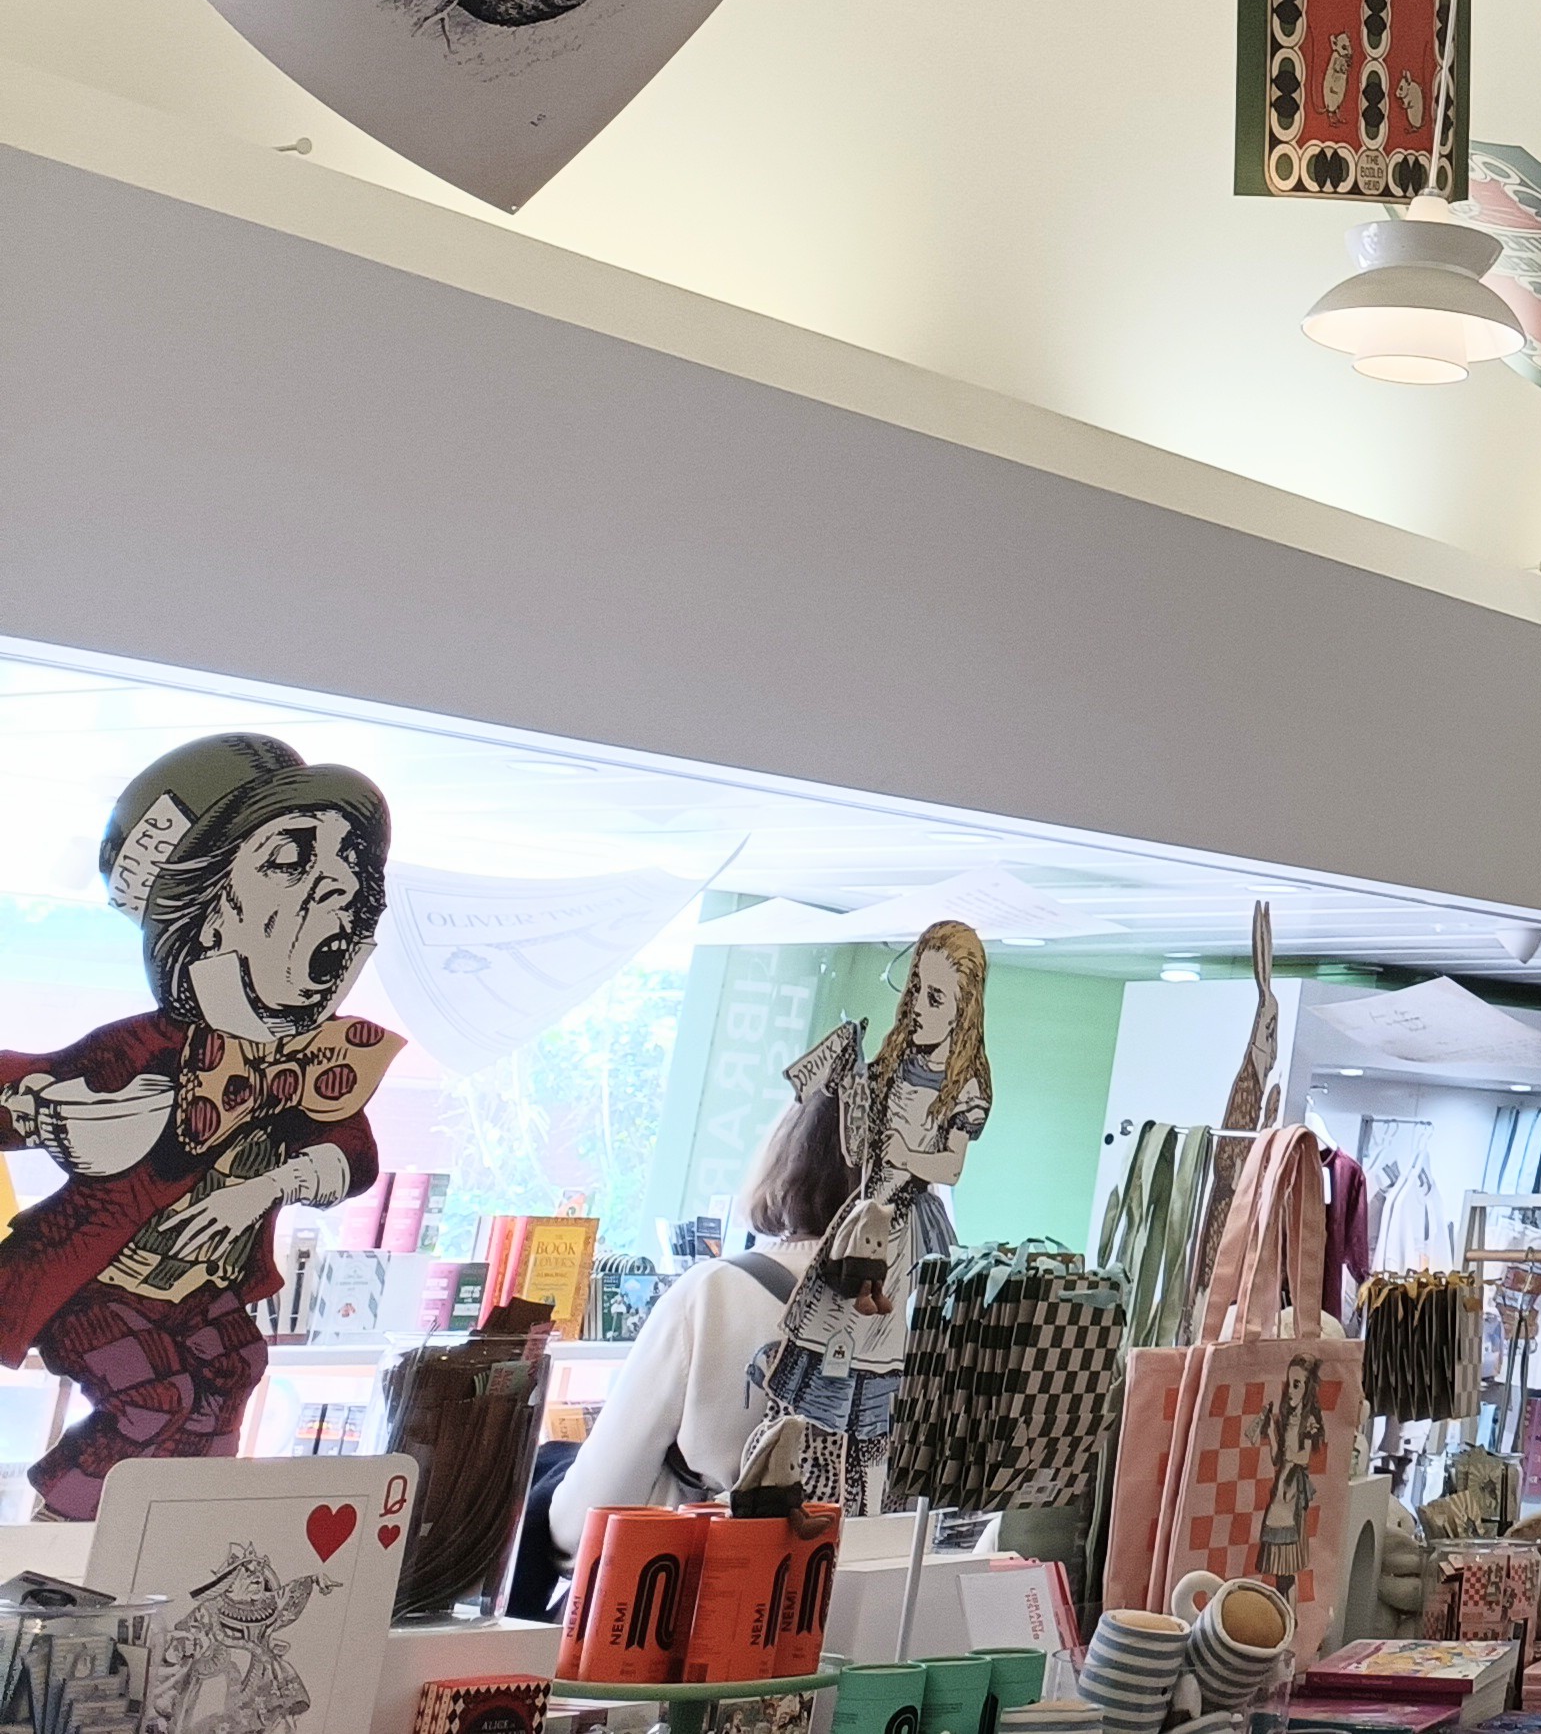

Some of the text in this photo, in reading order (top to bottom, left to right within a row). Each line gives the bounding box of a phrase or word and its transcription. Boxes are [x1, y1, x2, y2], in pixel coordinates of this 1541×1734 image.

[1365, 154, 1380, 166] THE
[427, 907, 534, 930] OLIVER
[792, 1039, 838, 1093] DRINK
[536, 1241, 577, 1256] BOOK
[378, 1474, 407, 1518] Q
[567, 1595, 582, 1638] NEMI
[609, 1601, 628, 1646] NEMI
[750, 1602, 766, 1646] NEMI
[781, 1590, 798, 1632] NEMI
